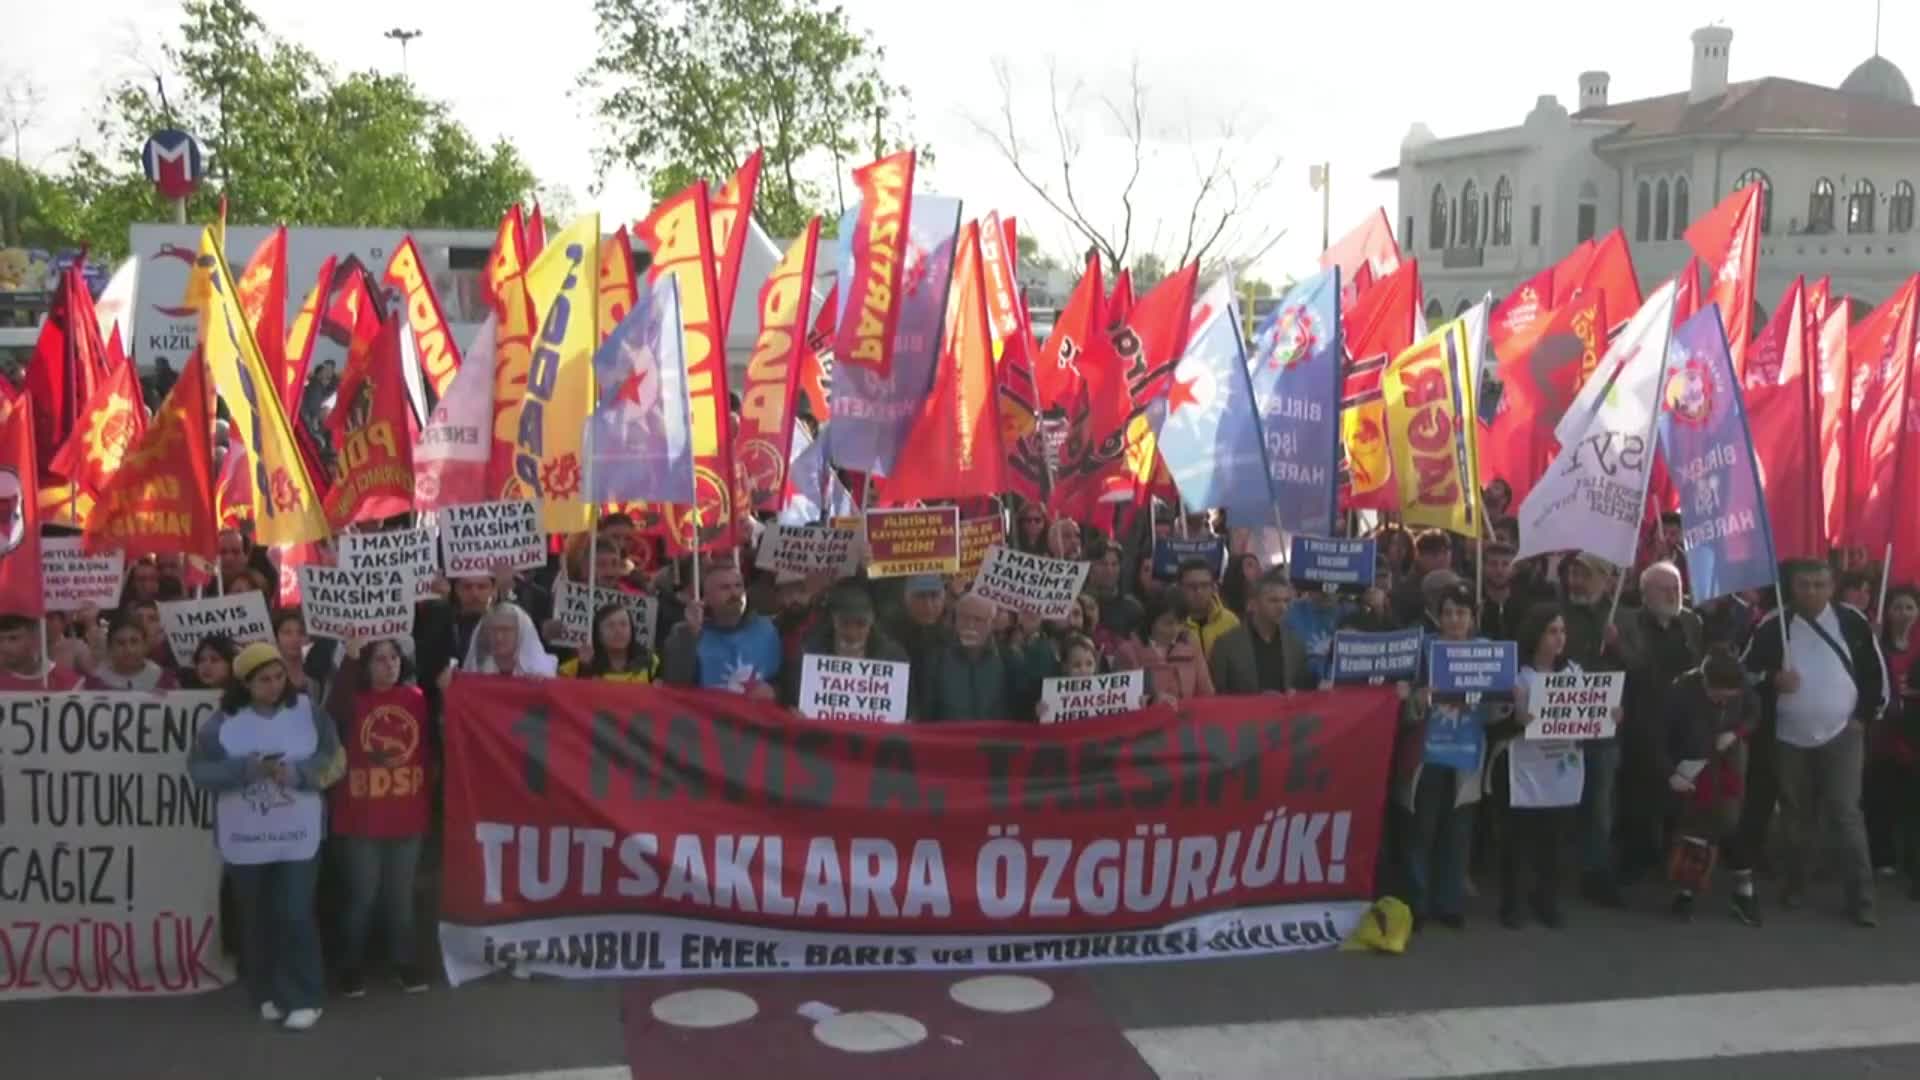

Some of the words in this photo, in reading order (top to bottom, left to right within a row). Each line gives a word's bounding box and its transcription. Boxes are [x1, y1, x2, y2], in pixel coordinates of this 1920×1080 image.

[151, 138, 191, 181] M
[448, 508, 455, 520] 1
[459, 502, 535, 520] MAYIS'A
[451, 517, 536, 538] TAKSİM'E
[362, 530, 430, 550] MAYIS'A
[449, 535, 541, 552] TUTSAKLARA
[350, 547, 431, 568] TAKSİM'E
[1007, 552, 1080, 576] MAYIS'A
[305, 568, 314, 582] 1
[319, 571, 403, 586] MAYIS'A
[992, 562, 1075, 589] TAKSİM'E
[308, 585, 403, 605] TAKSİM'E
[187, 606, 248, 625] MAYIS
[306, 602, 408, 620] TUTSAKLARA
[816, 658, 852, 674] HER
[858, 661, 894, 678] YER
[820, 676, 890, 695] TAKSİM
[1056, 679, 1092, 693] HER
[1097, 674, 1131, 690] YER
[1544, 676, 1577, 689] HER
[1582, 675, 1613, 688] YER
[814, 691, 851, 708] HER
[855, 695, 892, 713] YER
[1060, 689, 1127, 708] TAKSİM
[1546, 688, 1607, 705] TAKSİM
[1540, 706, 1573, 719] HER
[1577, 706, 1608, 718] YER
[1541, 720, 1602, 738] DİRENİŞ
[510, 704, 550, 793] 1
[475, 821, 952, 919] TUTSAKLARA
[976, 806, 1353, 919] ÖZGÜRLÜK!
